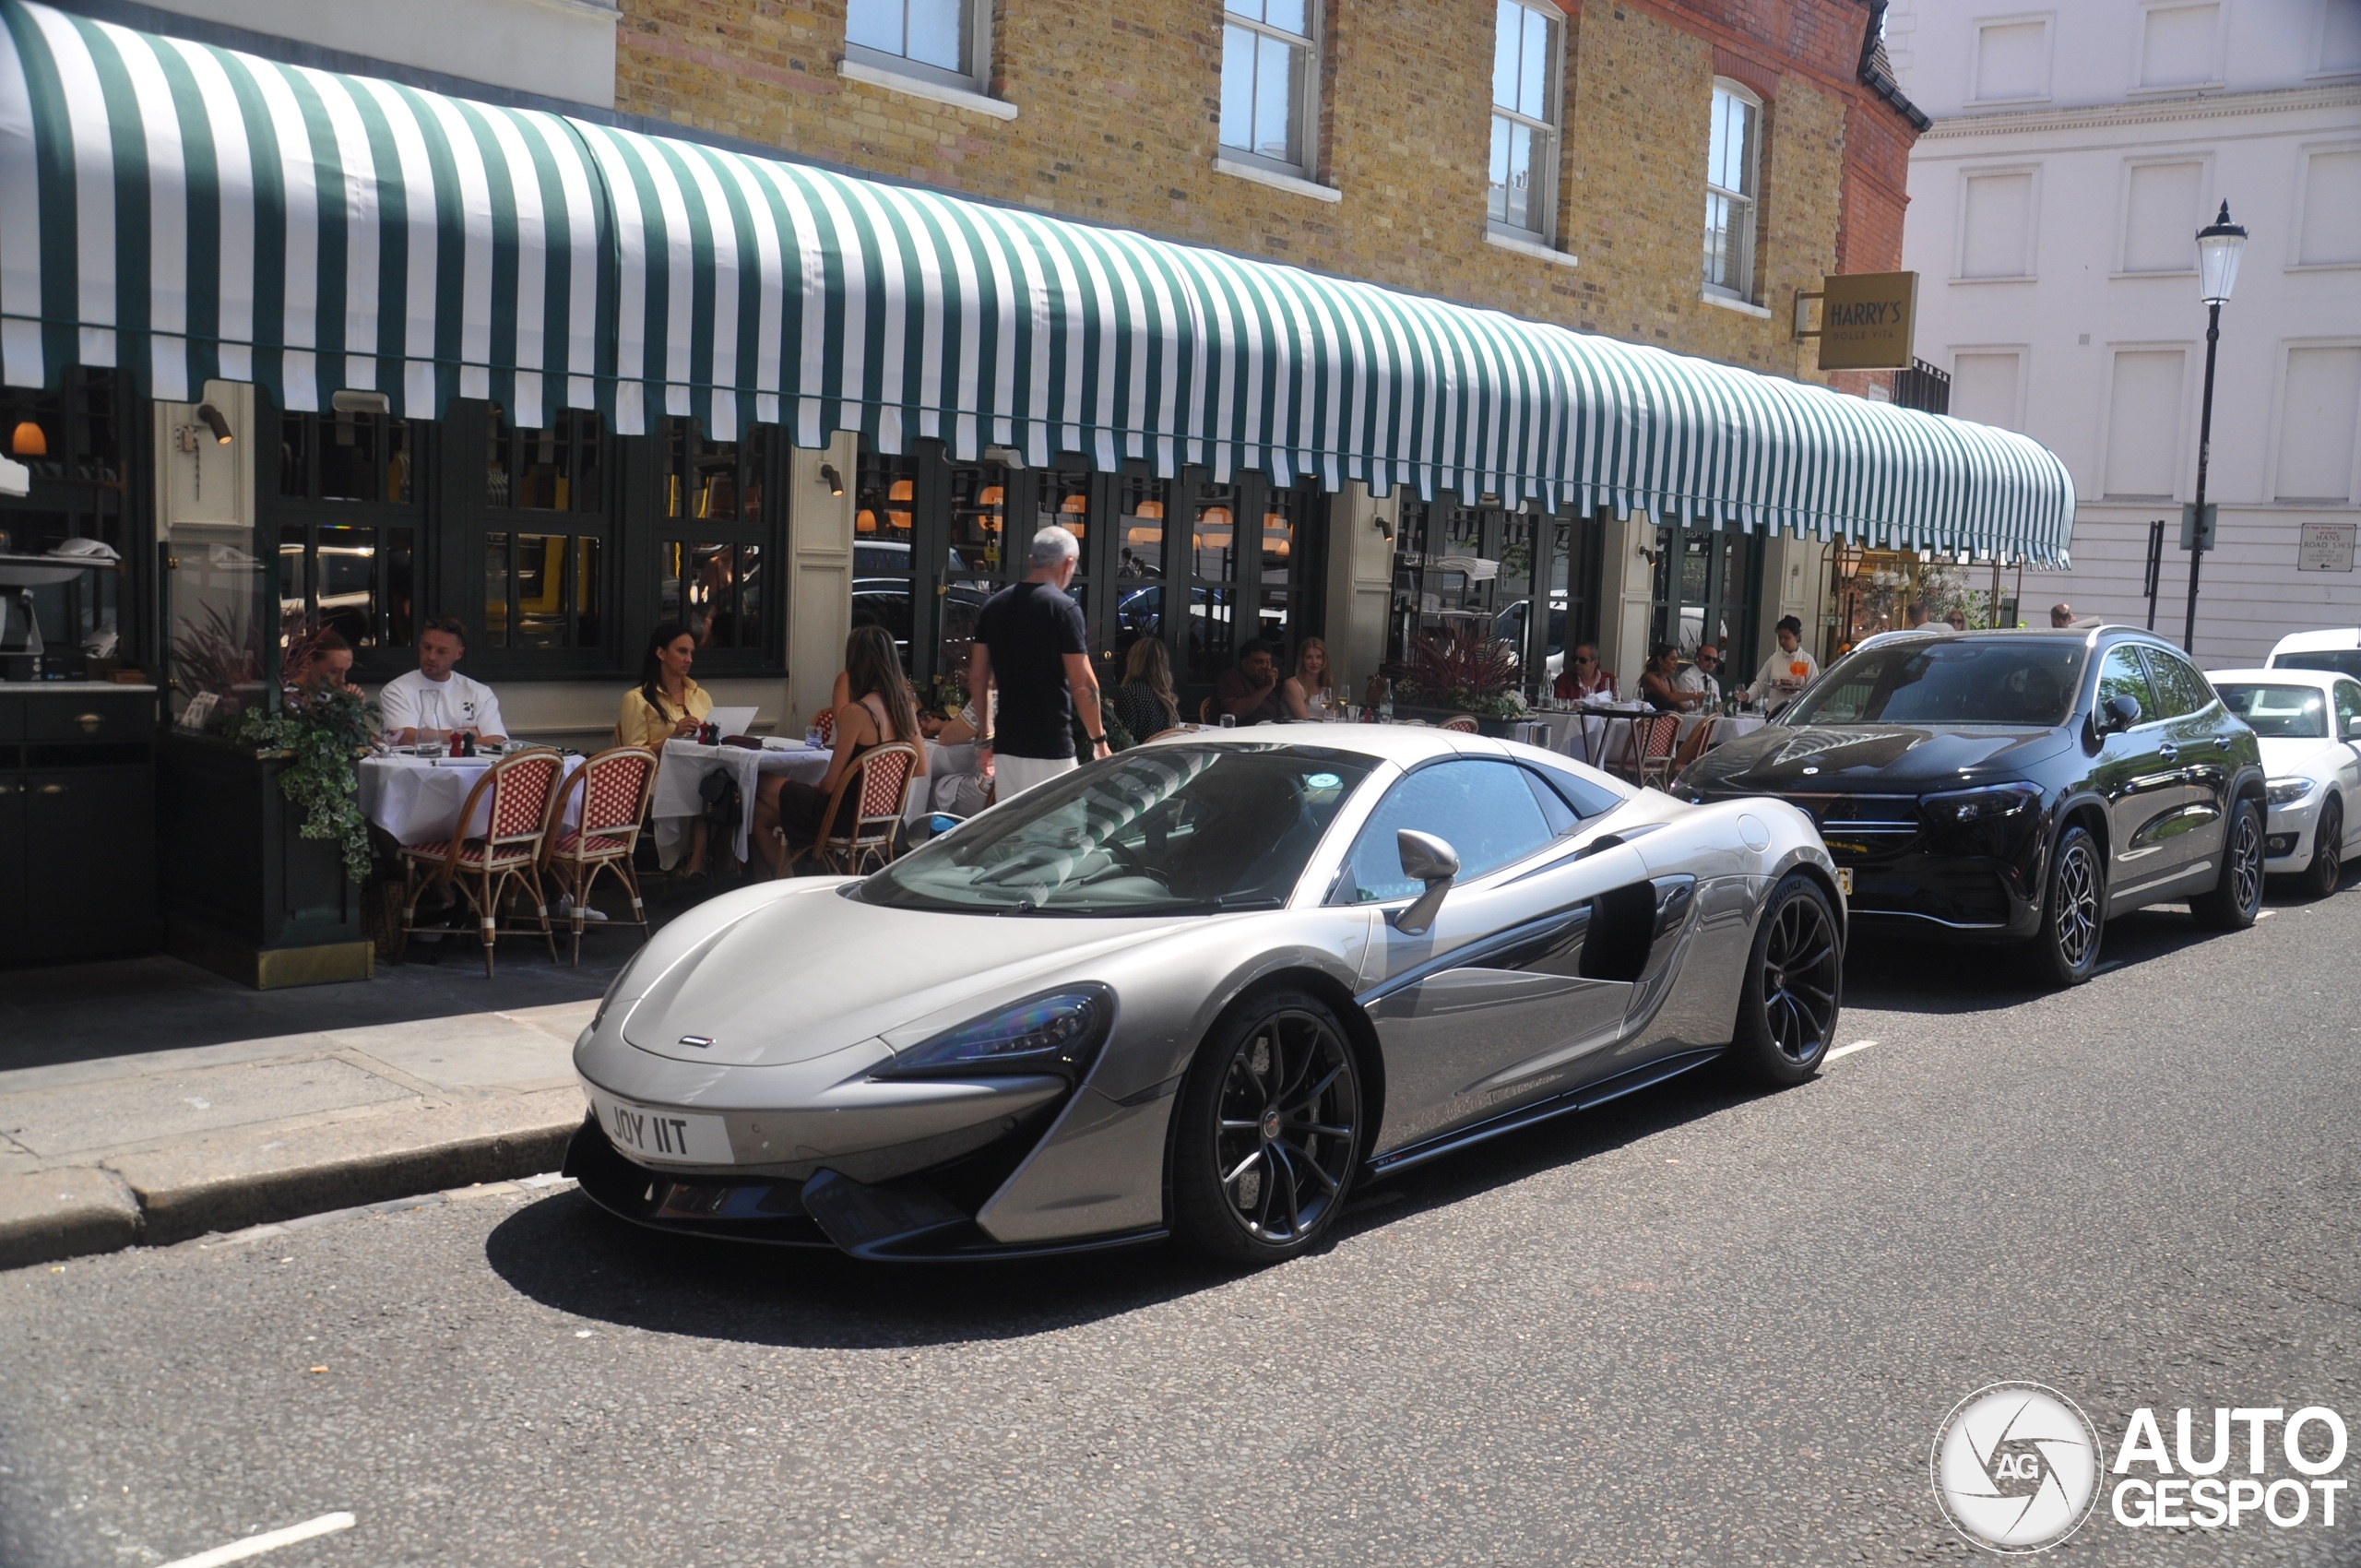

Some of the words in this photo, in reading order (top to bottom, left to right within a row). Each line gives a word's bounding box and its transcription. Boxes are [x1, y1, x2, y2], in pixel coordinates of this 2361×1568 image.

[1831, 301, 1902, 327] HARRY'S
[1833, 330, 1867, 341] DOLCE
[1872, 330, 1894, 339] VITA
[613, 1106, 644, 1149] JOY
